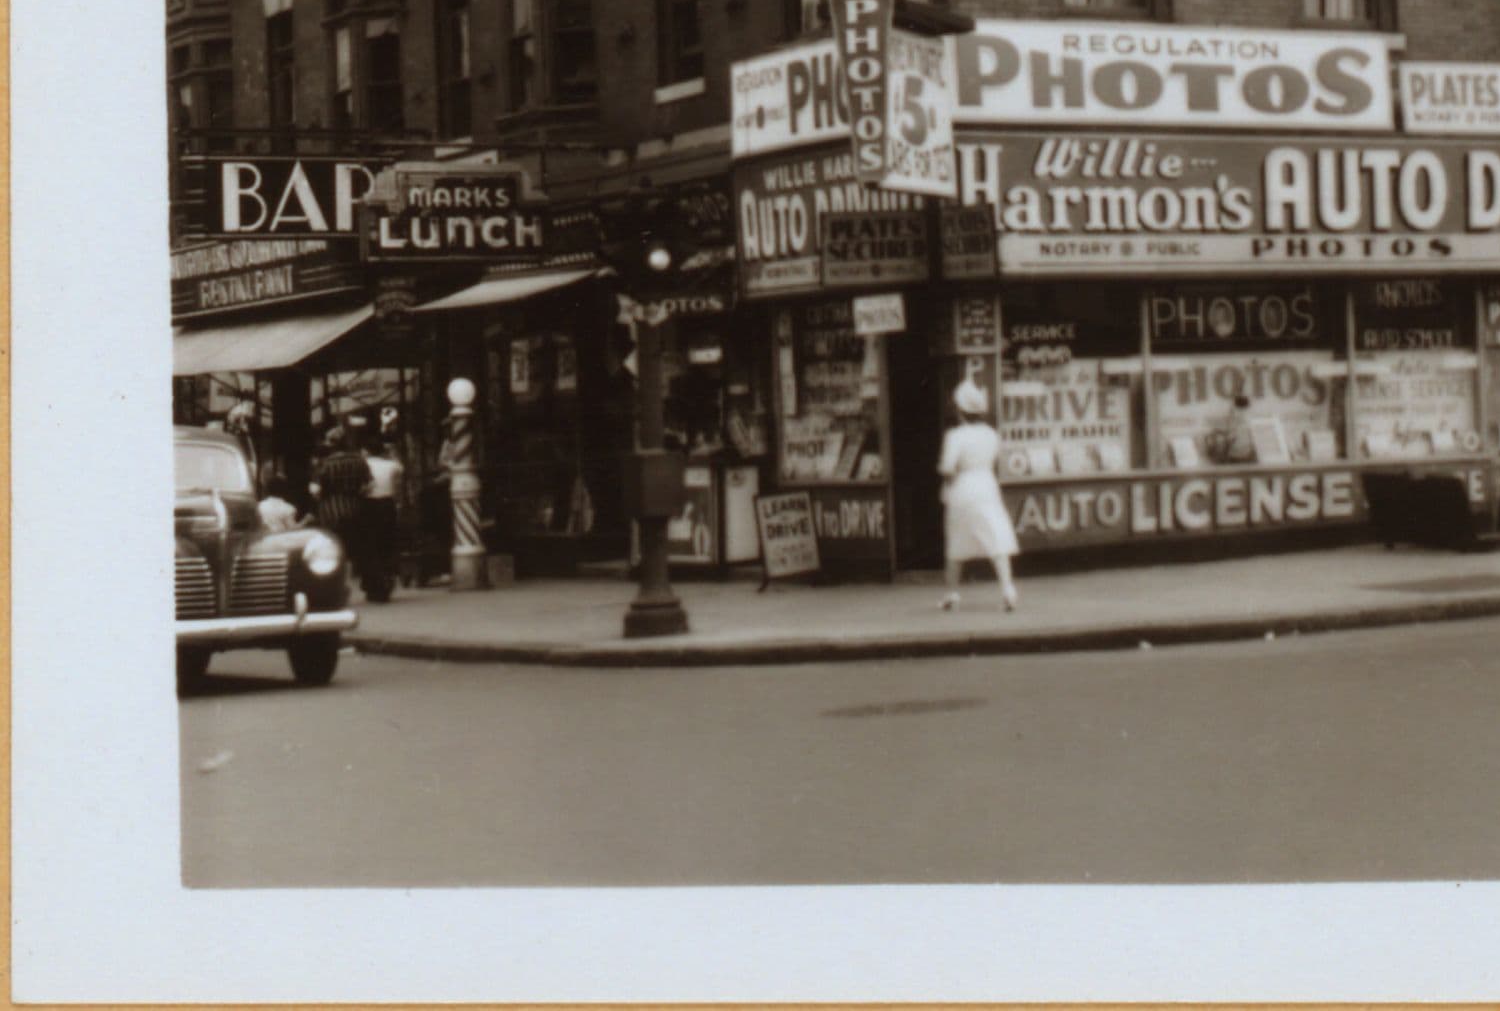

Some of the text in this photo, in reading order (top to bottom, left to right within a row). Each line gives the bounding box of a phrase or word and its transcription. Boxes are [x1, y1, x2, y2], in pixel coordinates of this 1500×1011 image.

[1063, 34, 1280, 60] REGULATION
[956, 34, 1375, 117] PHOTOS
[1409, 71, 1500, 108] PLATES
[1034, 137, 1184, 177] Willie
[763, 160, 816, 192] WILLIE
[1264, 146, 1448, 232] AUTO
[408, 186, 512, 209] MARKS
[378, 215, 544, 250] LUNCH
[740, 187, 809, 261] AUTO
[1039, 241, 1203, 258] NOTARY PUBLIC
[1251, 236, 1454, 259] PHOTOS
[1010, 323, 1077, 340] SERVICE
[1152, 292, 1316, 340] PHOTOS
[1152, 360, 1328, 407] PHOTOS
[1002, 389, 1118, 422] DRIVE
[763, 498, 808, 518] LEARN
[1016, 471, 1354, 535] AUTO LICENSE
[766, 517, 809, 540] DRIVE
